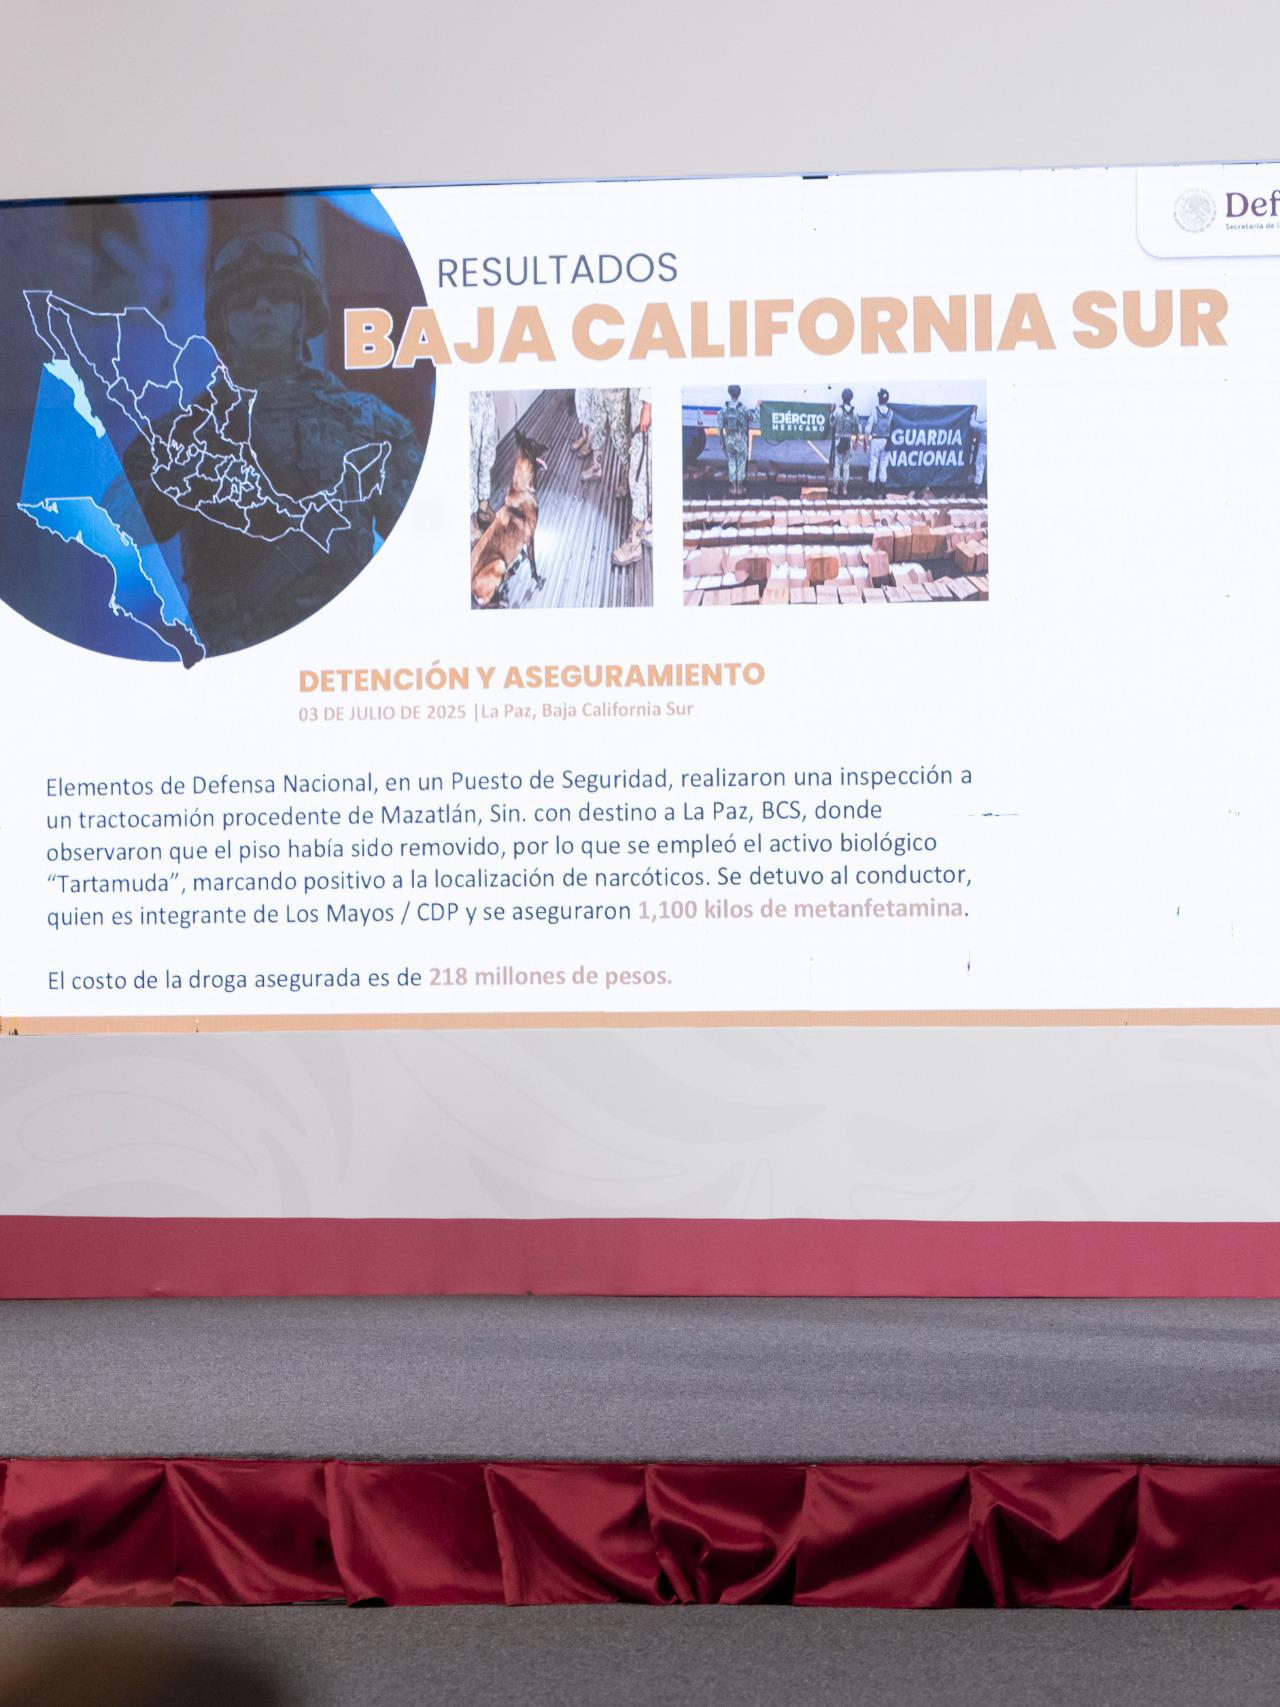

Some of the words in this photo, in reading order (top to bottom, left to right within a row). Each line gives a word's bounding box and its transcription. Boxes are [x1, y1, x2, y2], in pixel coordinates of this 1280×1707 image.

[439, 252, 677, 288] RESULTADOS
[343, 302, 556, 370] BAJA
[572, 293, 1056, 361] CALIFORNIA
[1073, 289, 1228, 349] SUR
[772, 410, 825, 425] EJÉRCITO
[772, 424, 825, 432] MEXICANO
[891, 429, 962, 446] GUARDIA
[887, 450, 965, 467] NACIONAL
[299, 660, 469, 693] DETENCIÓN
[476, 666, 496, 689] Y
[503, 662, 765, 689] ASEGURAMIENTO
[299, 707, 318, 722] 03
[324, 707, 344, 721] DE
[349, 706, 395, 721] JULIO
[401, 705, 421, 720] DE
[427, 704, 467, 720] 2025
[504, 704, 537, 720] Paz,
[542, 702, 577, 720] Baja
[582, 700, 661, 718] California
[666, 700, 695, 717] Sur
[47, 777, 153, 796] Elementos
[161, 776, 185, 795] de
[193, 774, 274, 794] Defensa
[284, 772, 378, 795] Nacional,
[386, 777, 410, 791] en
[419, 777, 442, 791] un
[452, 772, 522, 790] Puesto
[530, 769, 554, 789] de
[562, 768, 672, 793] Seguridad,
[682, 768, 785, 787] realizaron
[795, 772, 832, 786] una
[841, 764, 952, 790] inspección
[961, 770, 971, 784] a
[47, 816, 71, 829] un
[79, 808, 214, 829] tractocamión
[223, 806, 341, 831] procedente
[348, 805, 373, 824] de
[382, 803, 482, 826] Mazatlán,
[490, 804, 525, 822] Sin.
[534, 808, 570, 822] con
[579, 802, 656, 821] destino
[665, 807, 674, 821] a
[684, 802, 704, 820] La
[714, 801, 753, 823] Paz,
[763, 800, 806, 823] BCS,
[815, 799, 881, 819] donde
[47, 842, 161, 861] observaron
[170, 846, 207, 864] que
[215, 840, 231, 859] el
[240, 840, 280, 864] piso
[289, 838, 343, 858] había
[352, 837, 393, 857] sido
[401, 836, 505, 859] removido,
[514, 841, 549, 860] por
[556, 835, 573, 854] lo
[581, 840, 620, 859] que
[628, 840, 649, 854] se
[657, 833, 736, 858] empleó
[744, 833, 761, 853] el
[770, 833, 832, 852] activo
[841, 832, 936, 856] biológico
[193, 871, 296, 891] marcando
[304, 871, 385, 894] positivo
[393, 875, 402, 888] a
[412, 869, 427, 888] la
[435, 867, 554, 888] localización
[563, 867, 587, 886] de
[596, 866, 710, 887] narcóticos.
[718, 867, 741, 885] Se
[750, 865, 823, 885] detuvo
[831, 865, 847, 885] al
[856, 864, 971, 887] conductor,
[47, 907, 103, 931] quien
[112, 910, 133, 926] es
[141, 904, 246, 929] integrante
[253, 904, 278, 923] de
[286, 904, 319, 923] Los
[327, 904, 394, 928] Mayos
[400, 900, 411, 925] /
[417, 902, 459, 922] CDP
[466, 906, 477, 926] y
[481, 904, 505, 921] se
[512, 904, 630, 926] aseguraron
[639, 900, 697, 923] 1,100
[705, 899, 753, 919] kilos
[760, 898, 787, 918] de
[795, 898, 968, 918] metanfetamina.
[48, 970, 64, 990] El
[72, 972, 127, 991] costo
[134, 969, 158, 991] de
[166, 969, 183, 989] la
[189, 969, 246, 993] droga
[255, 967, 360, 992] asegurada
[368, 972, 390, 991] es
[397, 967, 421, 987] de
[430, 967, 467, 986] 218
[475, 966, 565, 985] millones
[572, 965, 598, 984] de
[606, 971, 672, 990] pesos.
